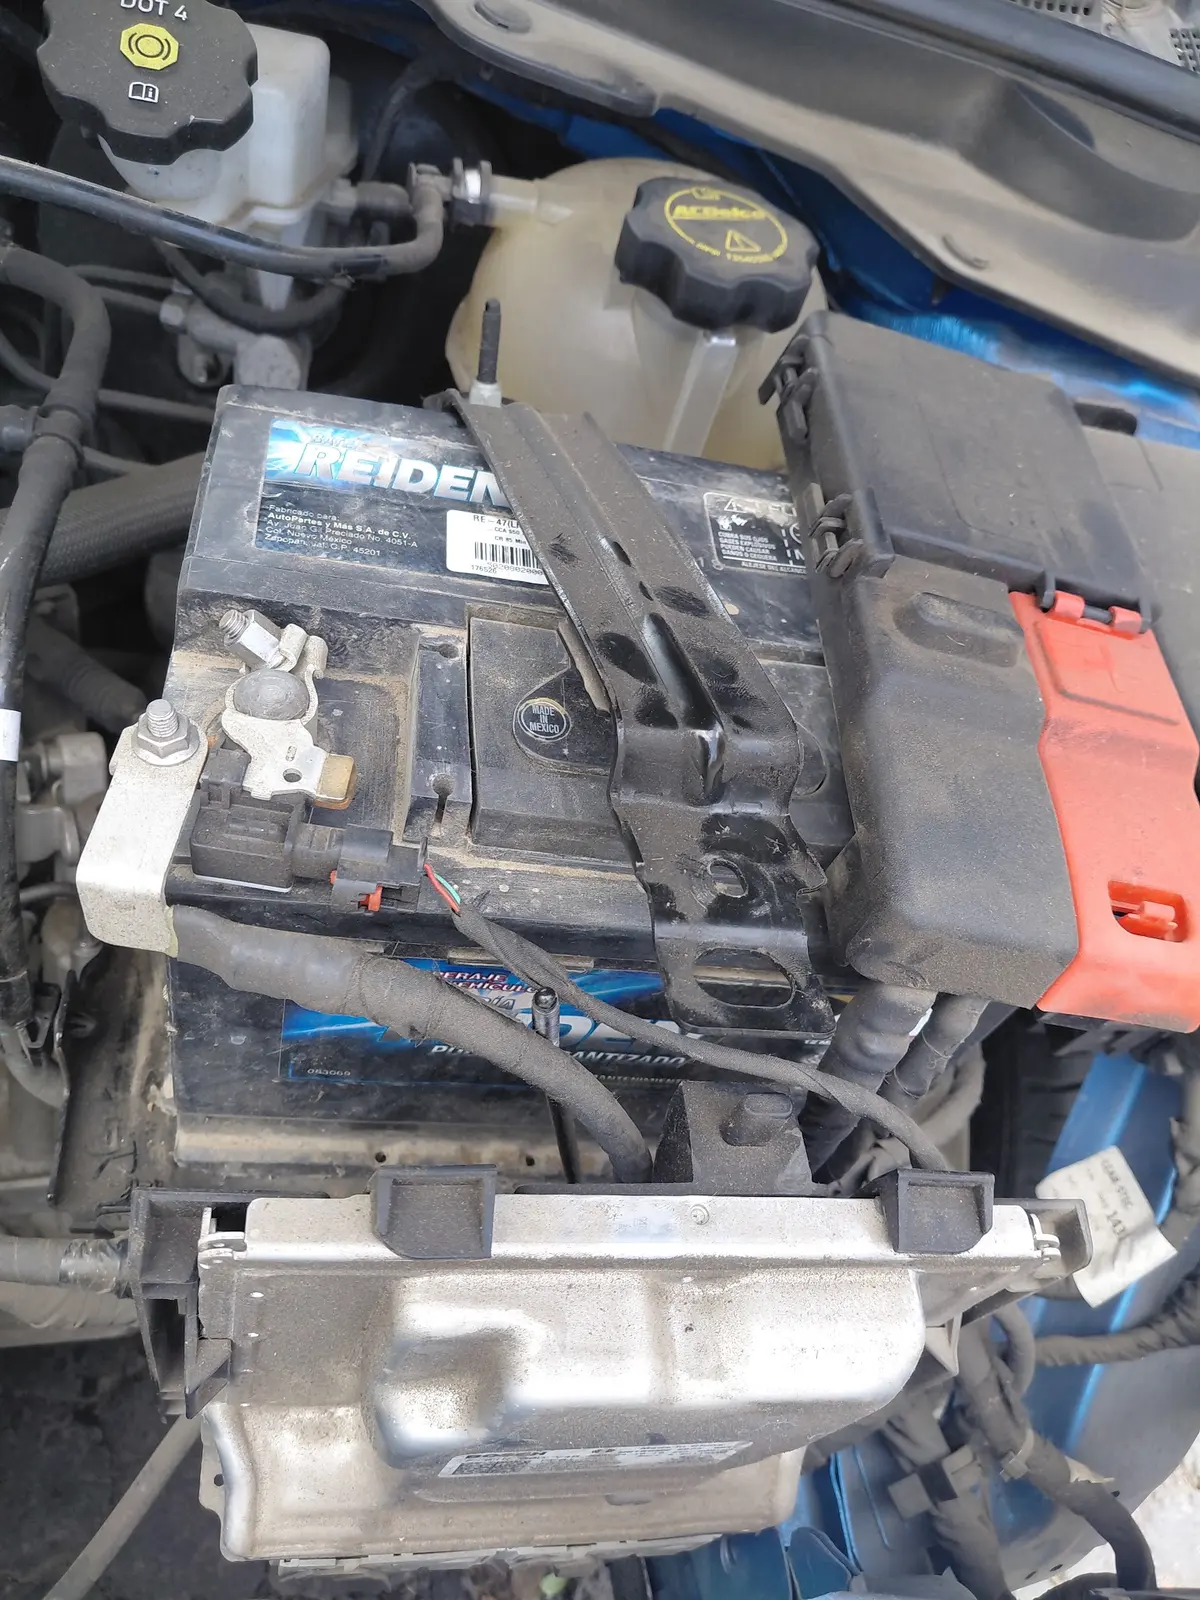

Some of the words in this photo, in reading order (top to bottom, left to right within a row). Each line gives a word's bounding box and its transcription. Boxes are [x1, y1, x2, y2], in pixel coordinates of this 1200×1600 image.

[174, 5, 188, 21] 4
[268, 504, 315, 518] Fabricado
[473, 514, 486, 524] RE
[267, 512, 322, 527] AutoPartes
[355, 524, 376, 534] S.A.
[378, 527, 390, 536] de
[392, 530, 411, 540] C.V.
[494, 526, 507, 534] CCA
[286, 529, 317, 541] Nuevo
[325, 527, 365, 540] Preciado
[367, 533, 383, 543] No.
[385, 537, 418, 548] 4051-A
[353, 546, 381, 556] 45201
[532, 704, 555, 716] MADE
[540, 714, 549, 724] IN
[529, 721, 560, 734] MEXICO
